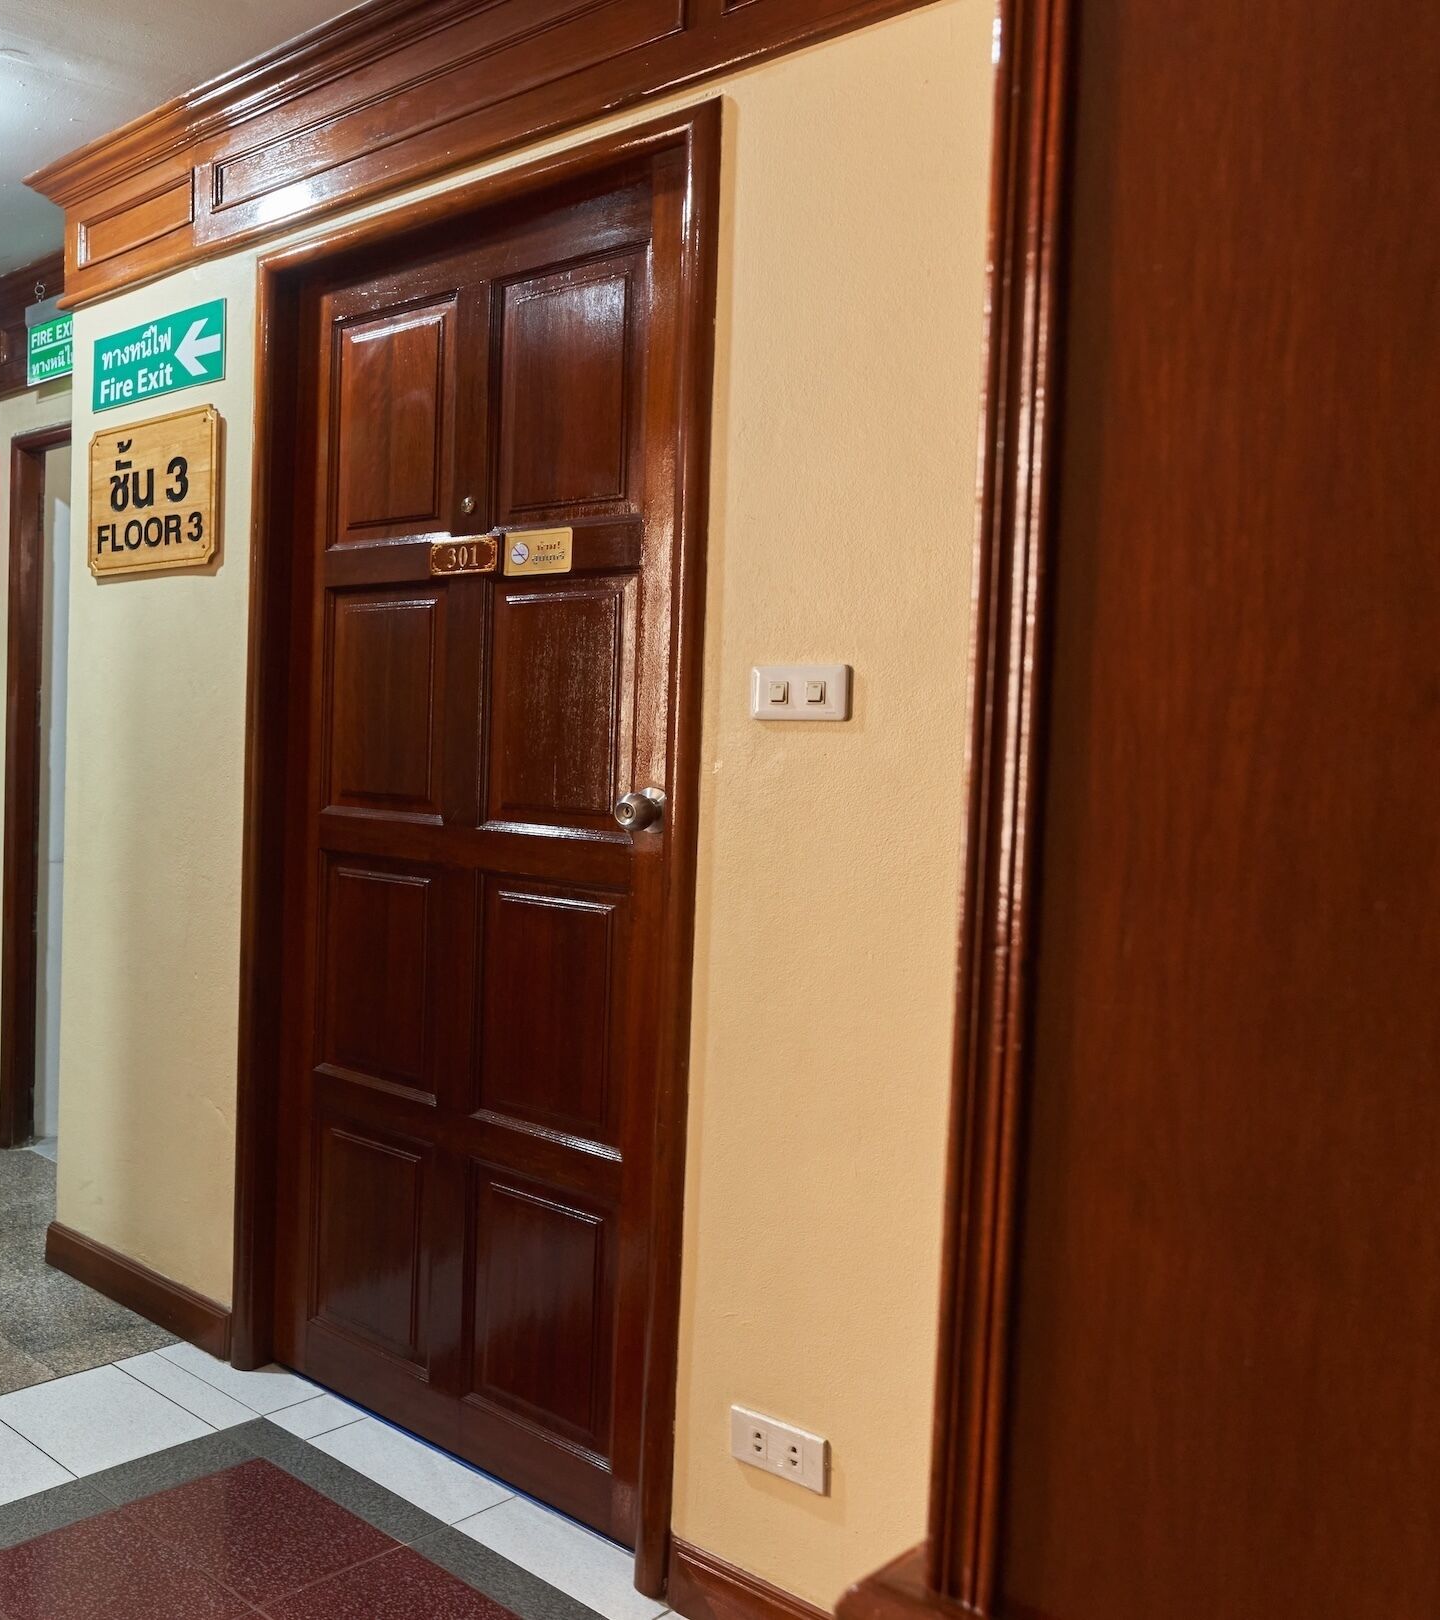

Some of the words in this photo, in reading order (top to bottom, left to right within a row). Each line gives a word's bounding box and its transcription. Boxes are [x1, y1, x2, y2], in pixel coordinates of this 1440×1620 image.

[31, 326, 54, 349] FIRE
[55, 320, 73, 341] EXI
[101, 324, 173, 371] ทางหนีไฟ
[31, 344, 73, 376] ทางหนีไ
[99, 376, 134, 405] Fire
[137, 362, 174, 395] Exit
[110, 439, 155, 513] ชั้น
[165, 456, 190, 503] 3
[96, 514, 182, 555] FLOOR
[187, 511, 204, 543] 3
[446, 545, 479, 569] 301
